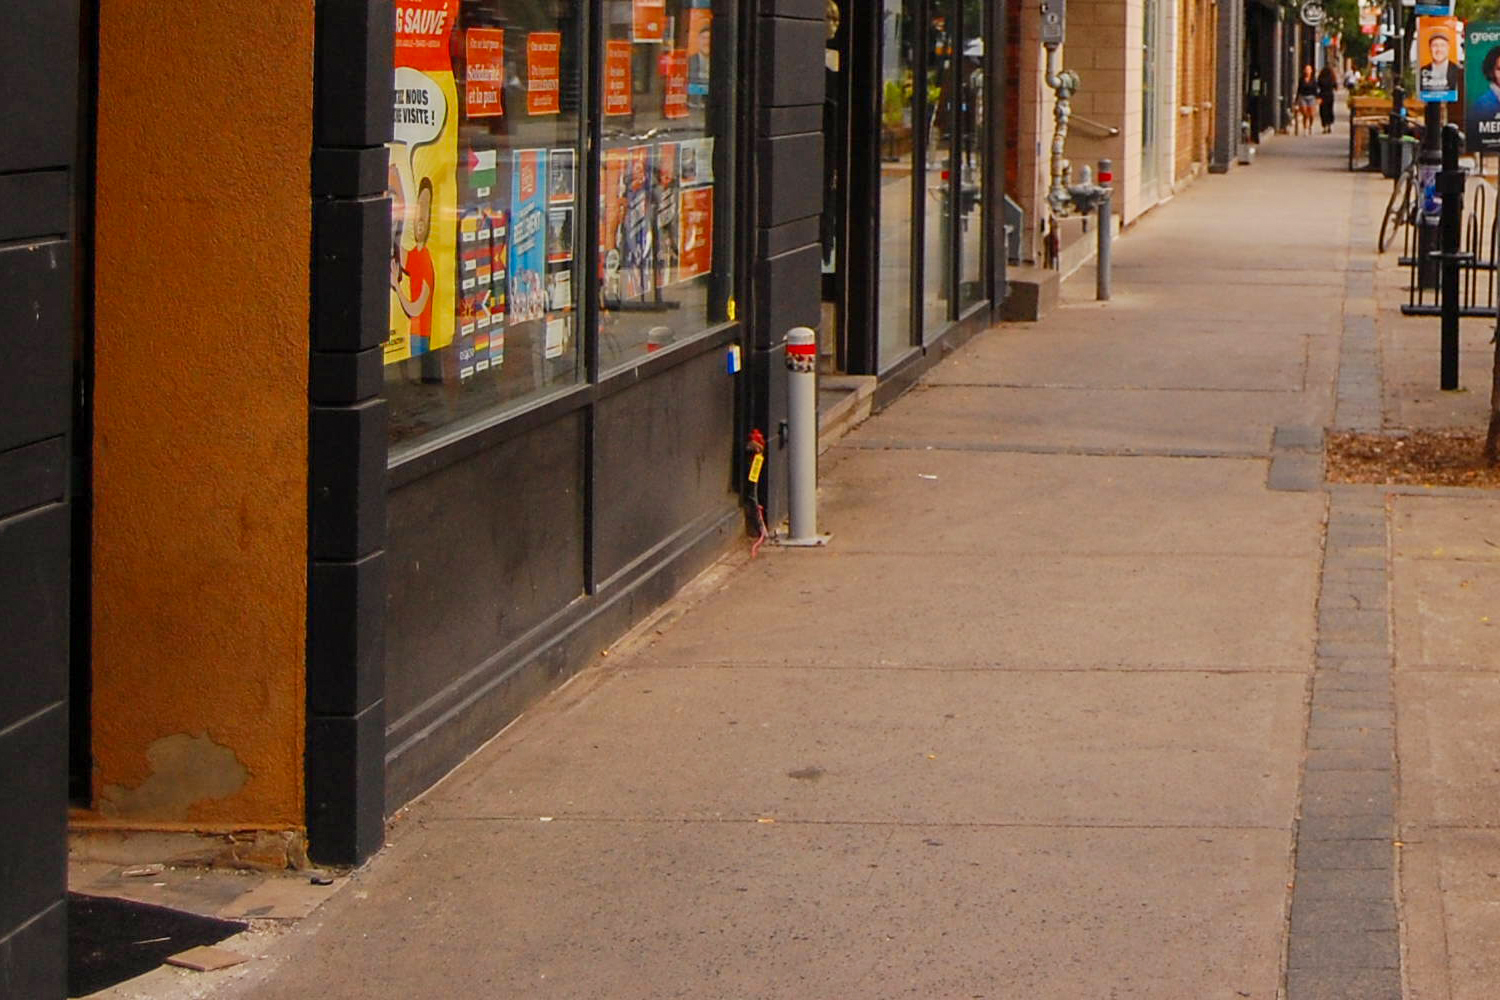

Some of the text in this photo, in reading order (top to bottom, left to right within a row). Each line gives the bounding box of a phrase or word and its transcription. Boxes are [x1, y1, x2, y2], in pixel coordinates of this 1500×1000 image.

[404, 2, 448, 35] SAUVÉ
[406, 89, 429, 106] NOUS
[403, 108, 429, 125] VISITE
